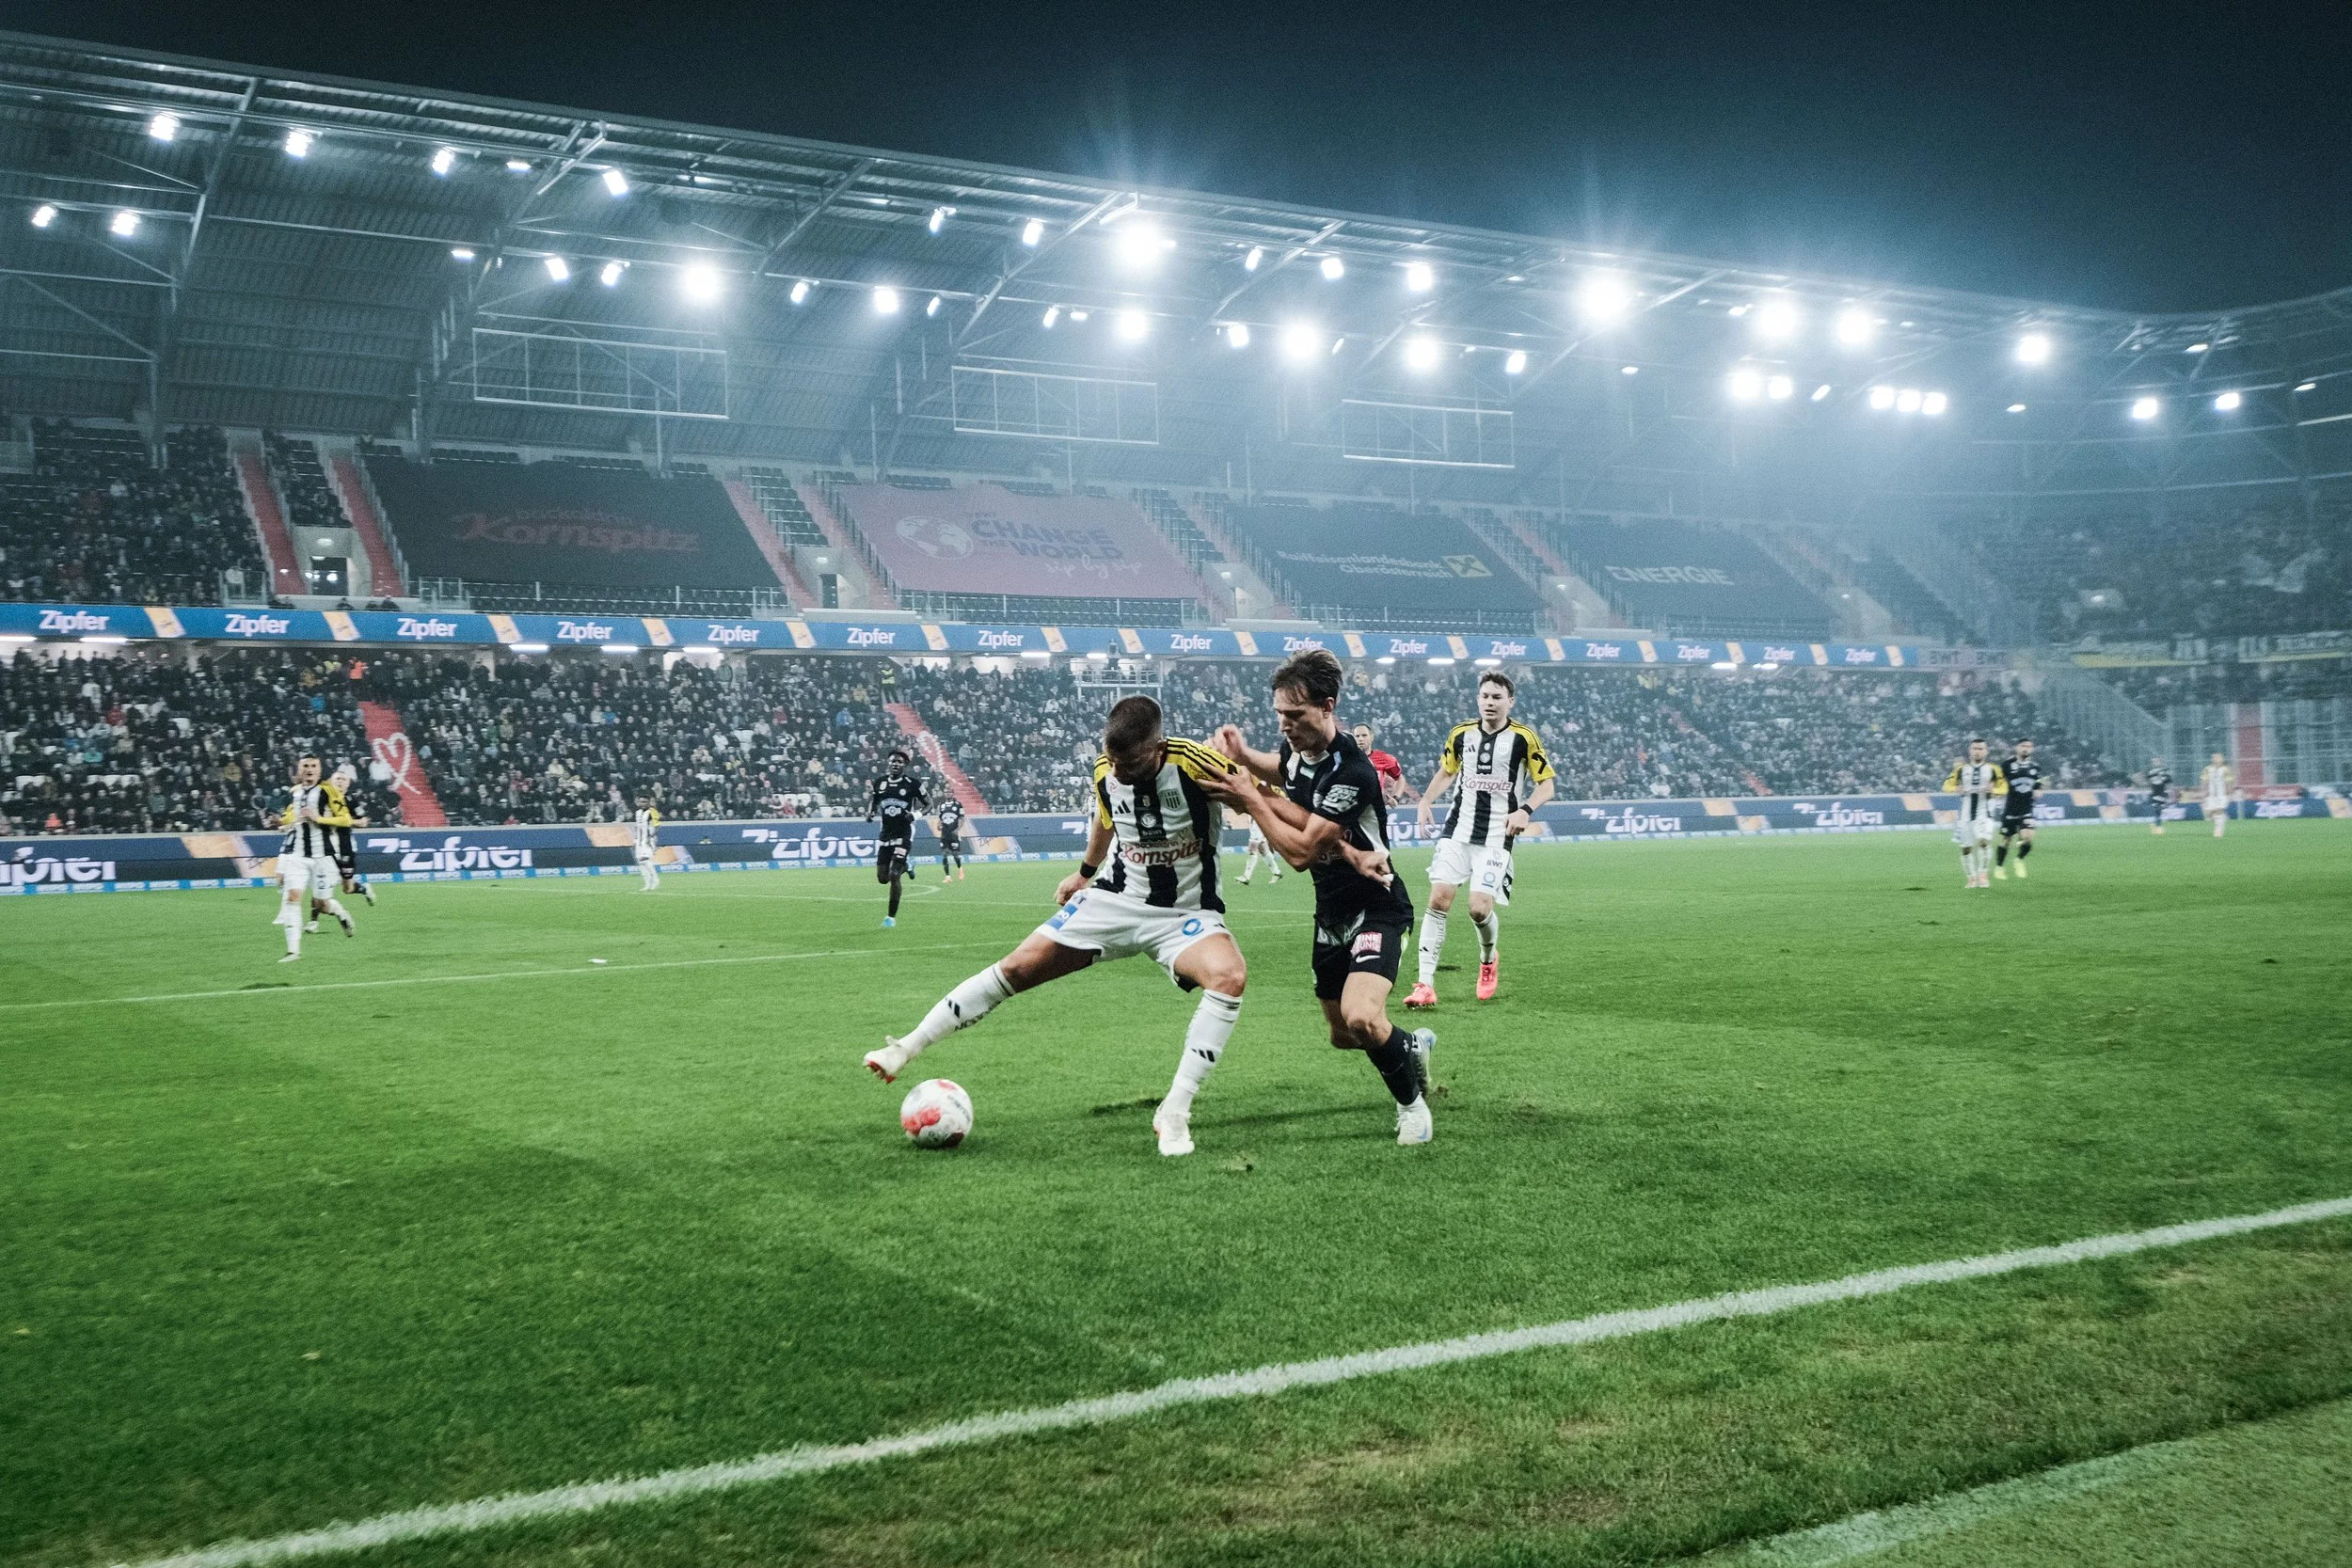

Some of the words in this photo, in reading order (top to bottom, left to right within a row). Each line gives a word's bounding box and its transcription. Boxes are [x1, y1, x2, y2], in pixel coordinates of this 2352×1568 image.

[451, 513, 702, 554] Kornspitz
[971, 518, 1115, 546] CHANGE
[1009, 541, 1126, 560] WORLD
[1604, 565, 1735, 585] ENERGIE
[39, 610, 110, 633] Zipfer
[225, 613, 290, 637] Zipfer
[397, 618, 457, 640] Zipfer
[557, 621, 612, 642] Zipfer
[707, 625, 760, 644] Zipfer
[847, 627, 896, 647] Zipfer
[977, 630, 1024, 649] Zipfer
[1170, 634, 1212, 652] Zipfer
[1390, 639, 1428, 656] Zipfer
[1490, 641, 1526, 657] Zipfer
[1586, 642, 1620, 659] Zipfer
[1677, 644, 1710, 661] Zipfer
[1463, 777, 1512, 792] Kornspitz
[1120, 840, 1201, 864] Kornspitz
[0, 847, 117, 886] ipfer
[1486, 859, 1503, 869] BWT
